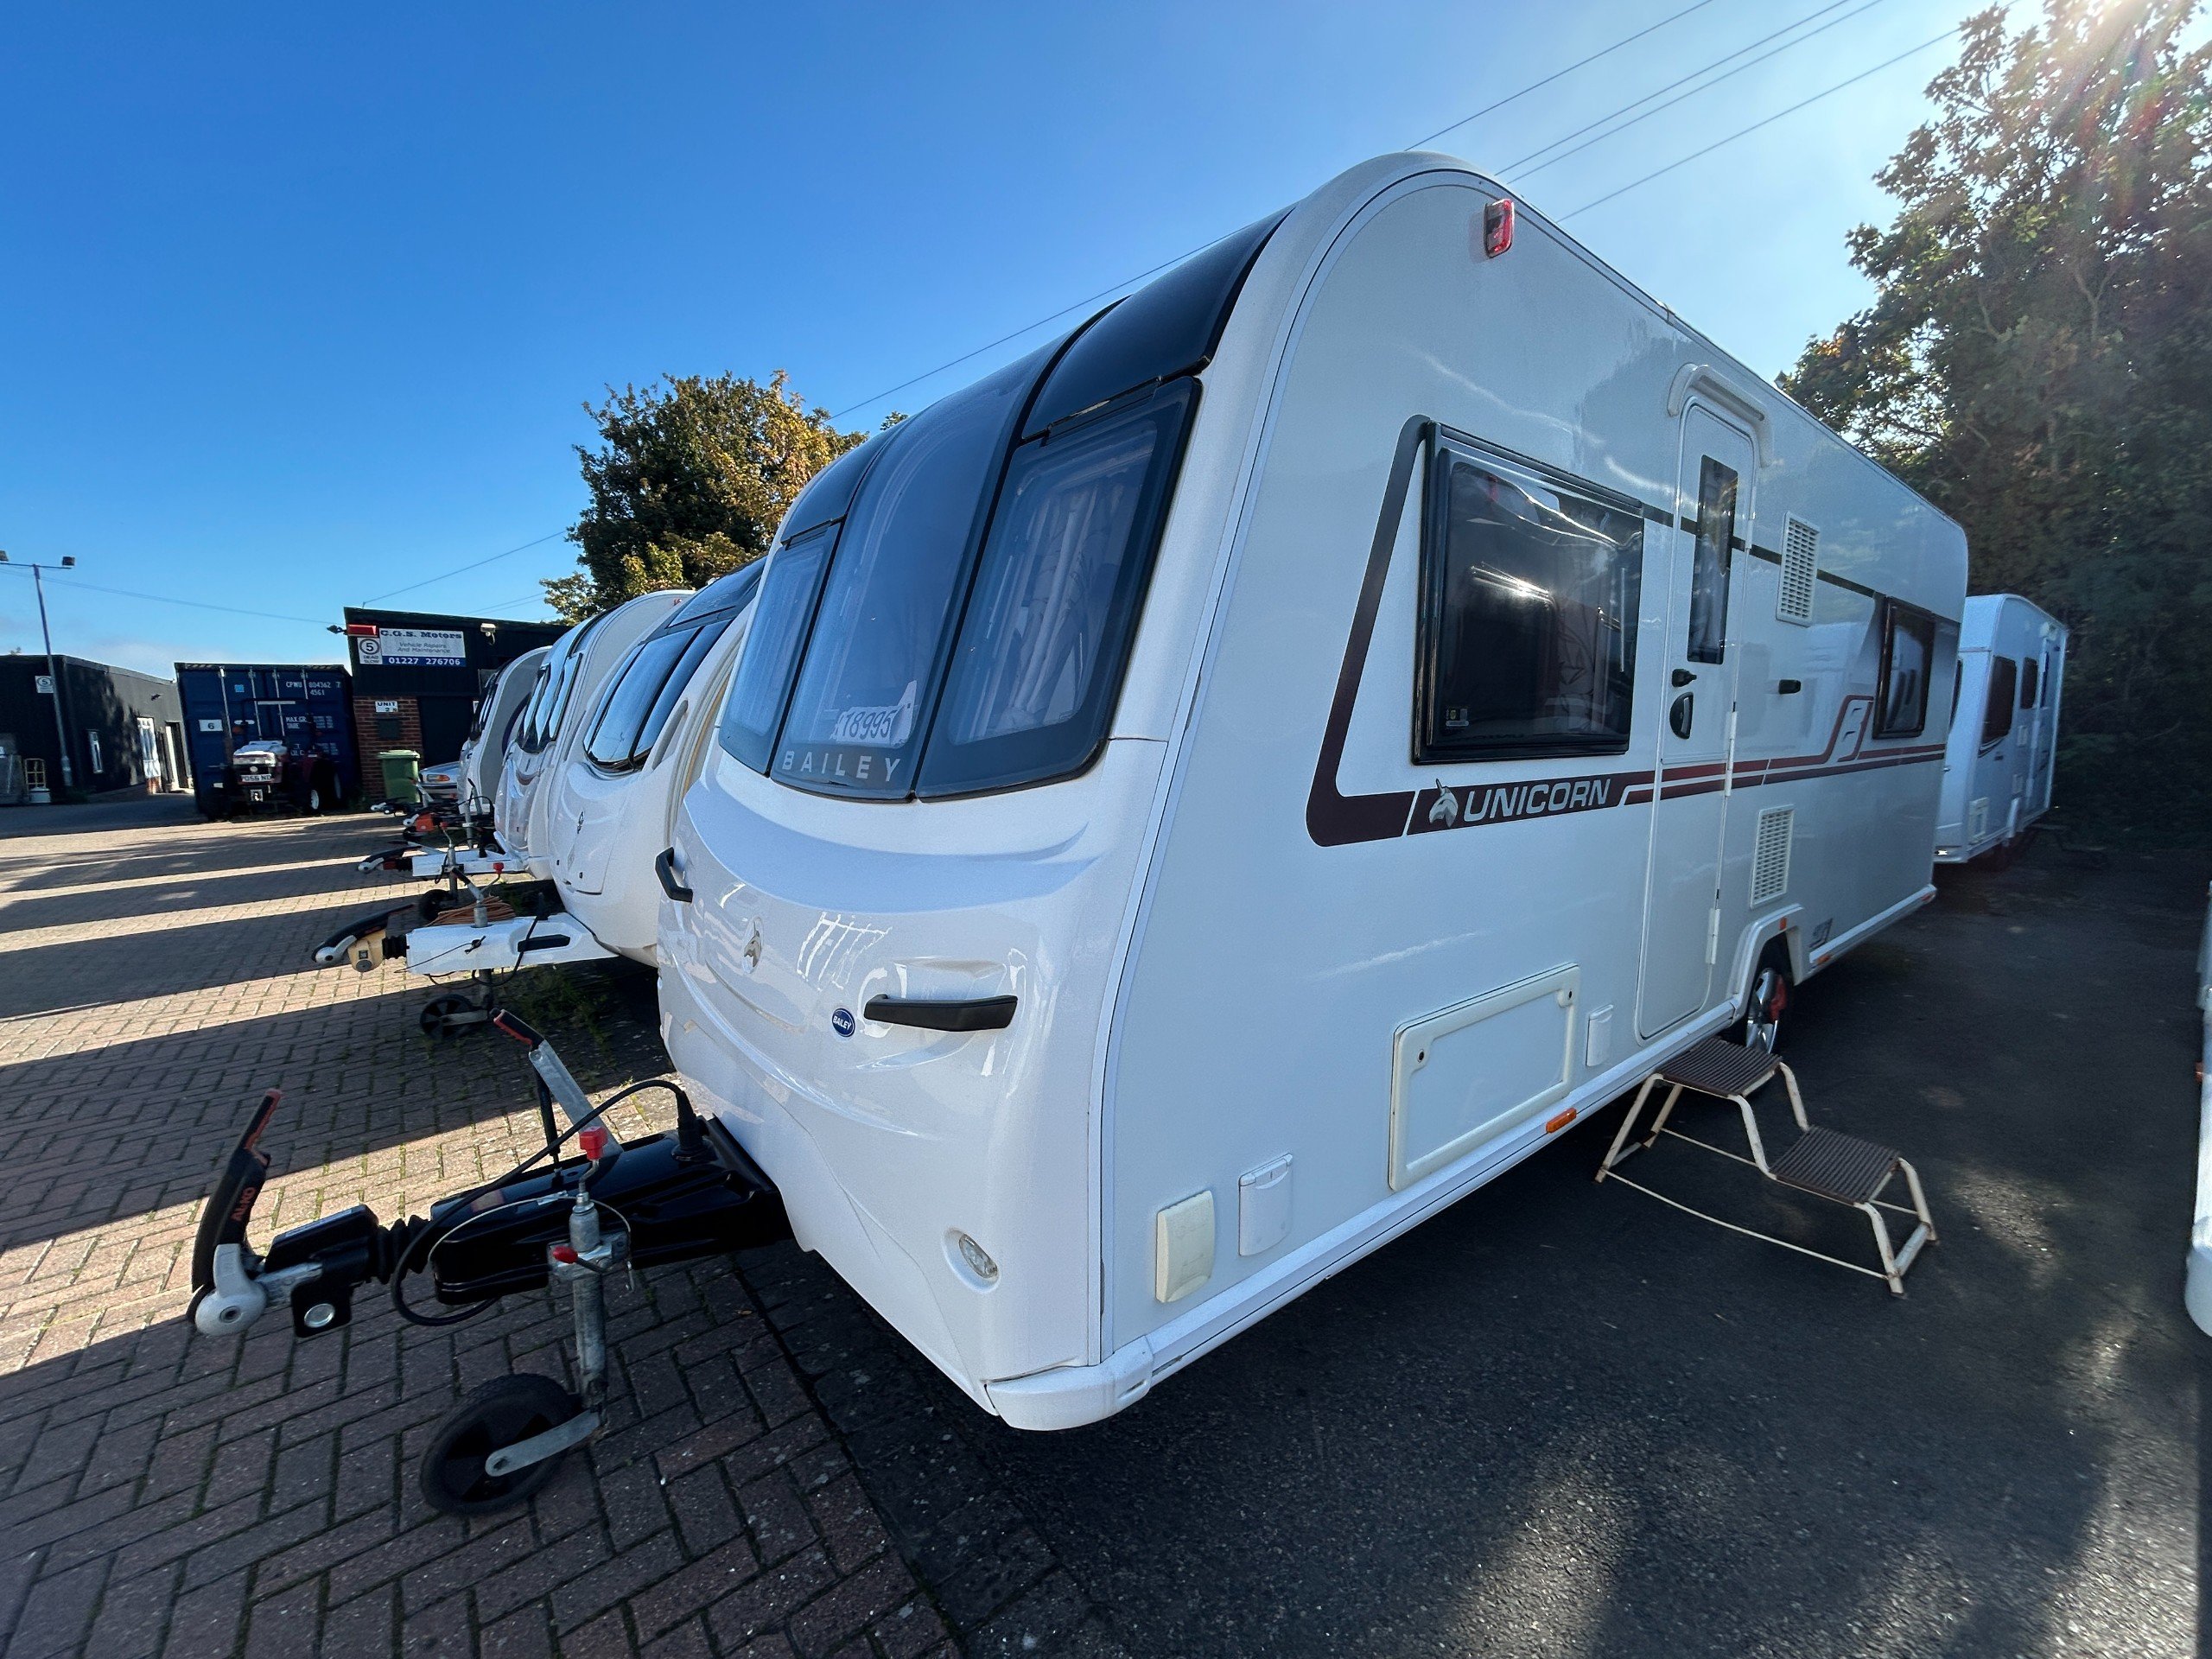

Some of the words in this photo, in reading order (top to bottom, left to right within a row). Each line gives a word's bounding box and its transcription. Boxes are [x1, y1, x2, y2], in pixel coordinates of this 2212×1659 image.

[365, 642, 374, 652] 5
[781, 750, 900, 782] BAILEY
[1463, 778, 1611, 822] UNICORN
[832, 1014, 852, 1030] BAILEY
